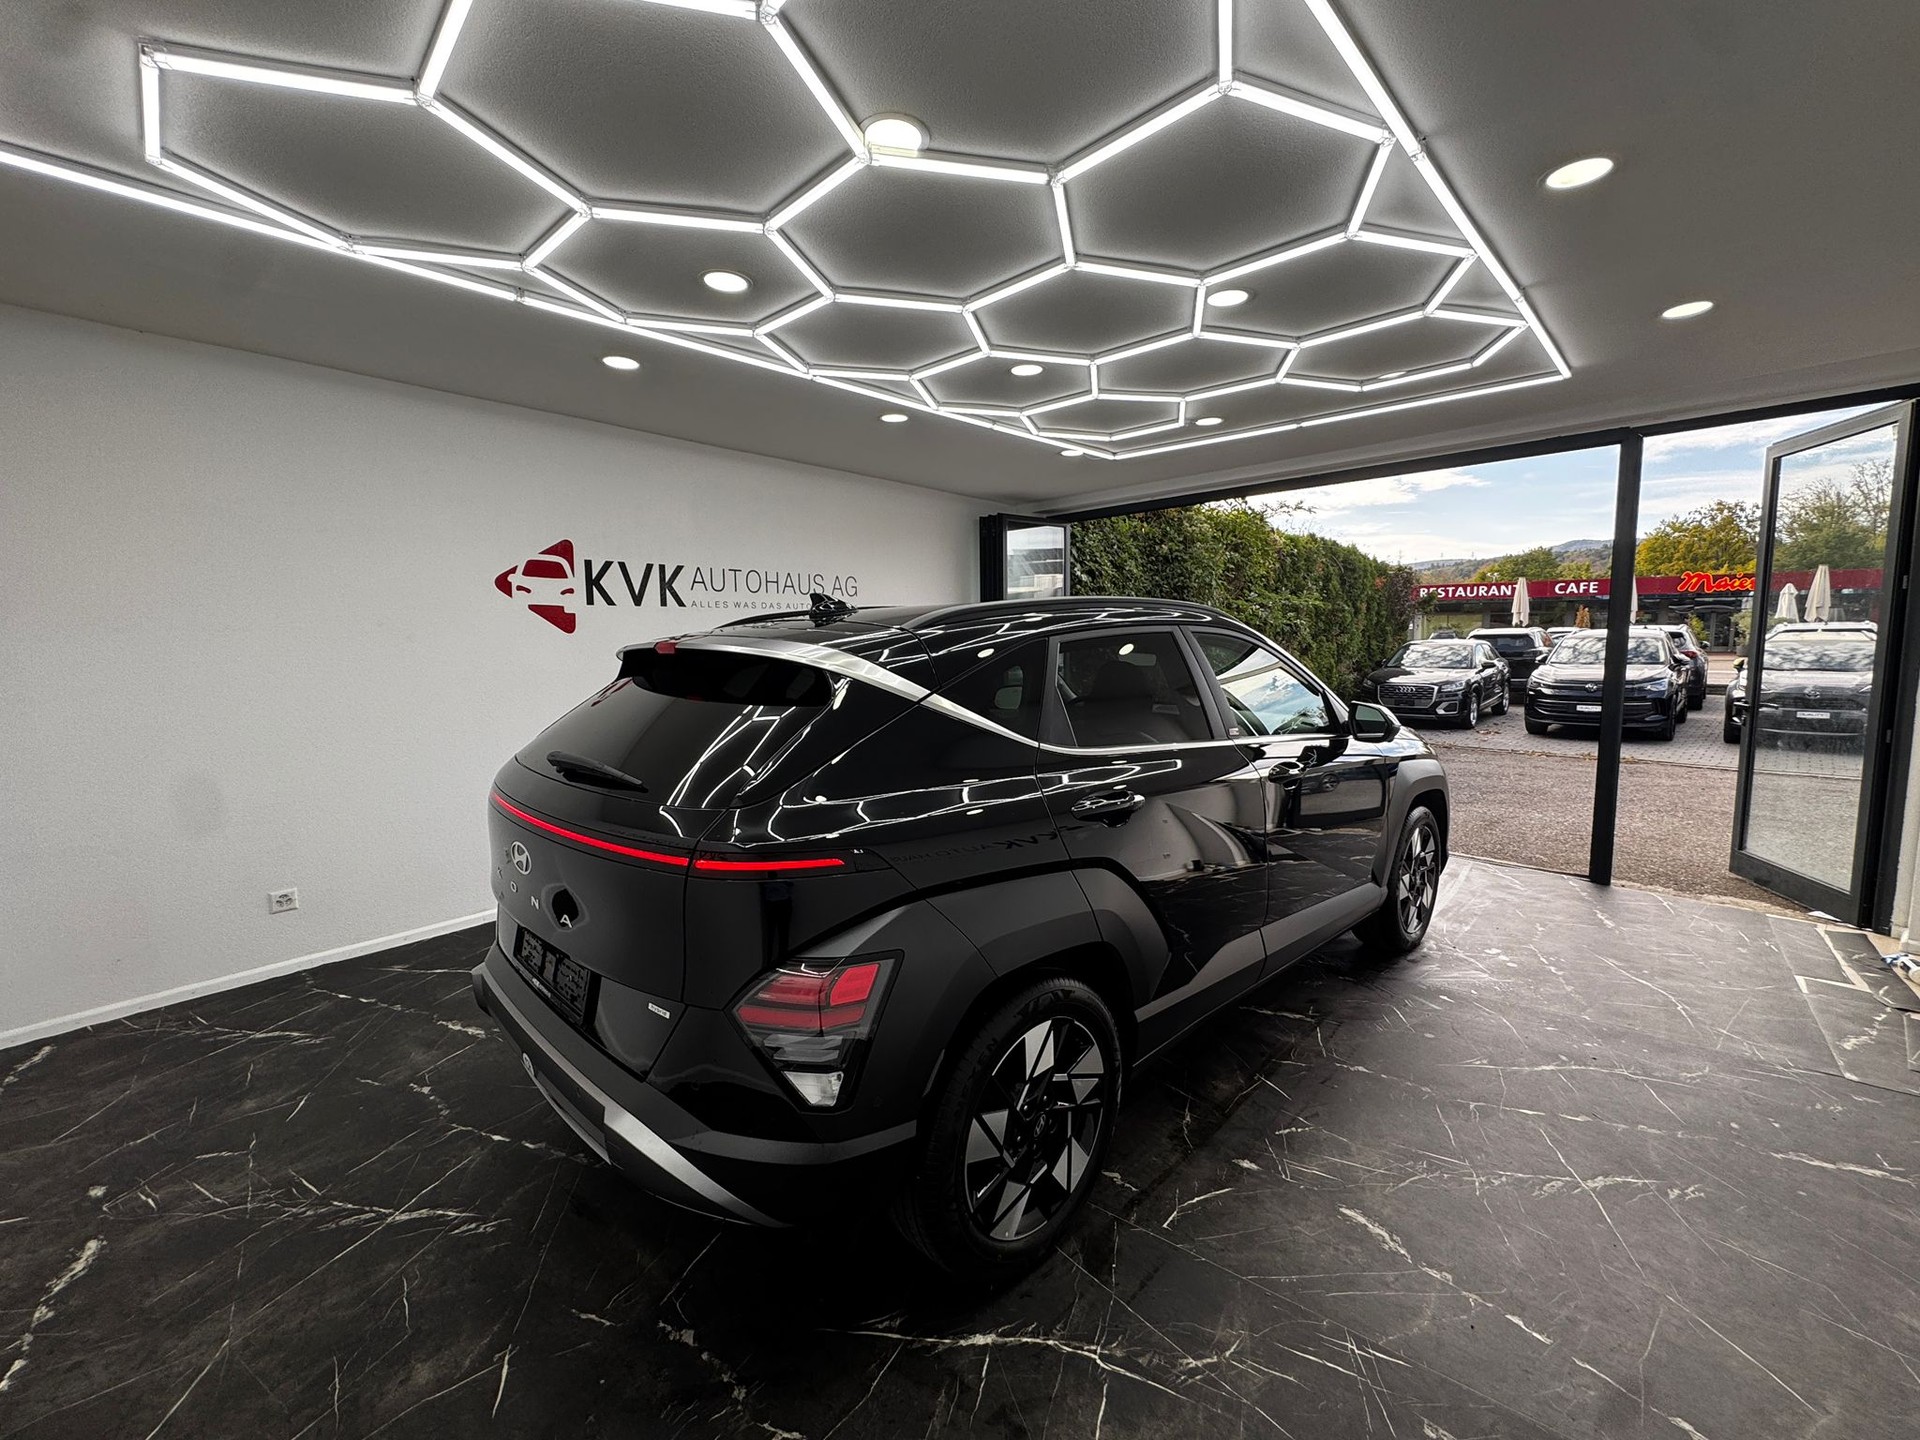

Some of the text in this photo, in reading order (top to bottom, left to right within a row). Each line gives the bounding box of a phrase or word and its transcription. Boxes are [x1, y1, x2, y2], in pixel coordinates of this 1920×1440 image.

[583, 559, 858, 608] KVK AUTOHAUS AG
[1554, 581, 1599, 595] CAFE
[691, 600, 729, 609] ALLES
[733, 601, 757, 610] WAS
[761, 601, 782, 610] DAS
